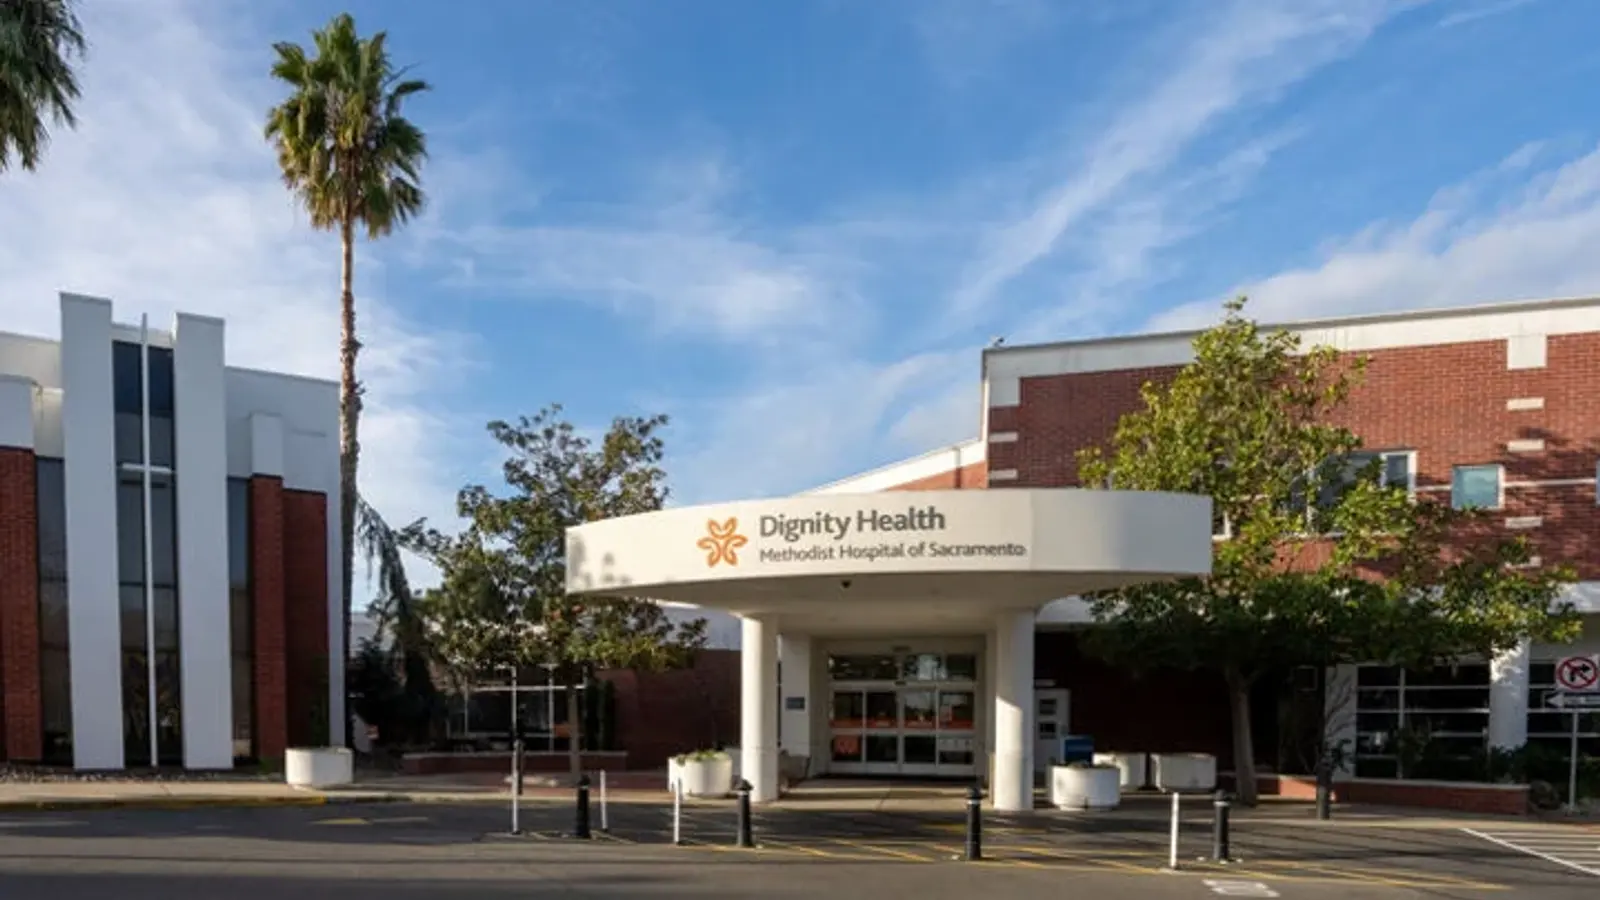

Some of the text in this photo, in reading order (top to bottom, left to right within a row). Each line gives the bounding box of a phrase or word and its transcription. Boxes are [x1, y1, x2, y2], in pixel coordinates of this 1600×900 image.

[760, 505, 945, 542] Dignity Health
[759, 541, 1026, 563] Methodist Hospital of Sacramento
